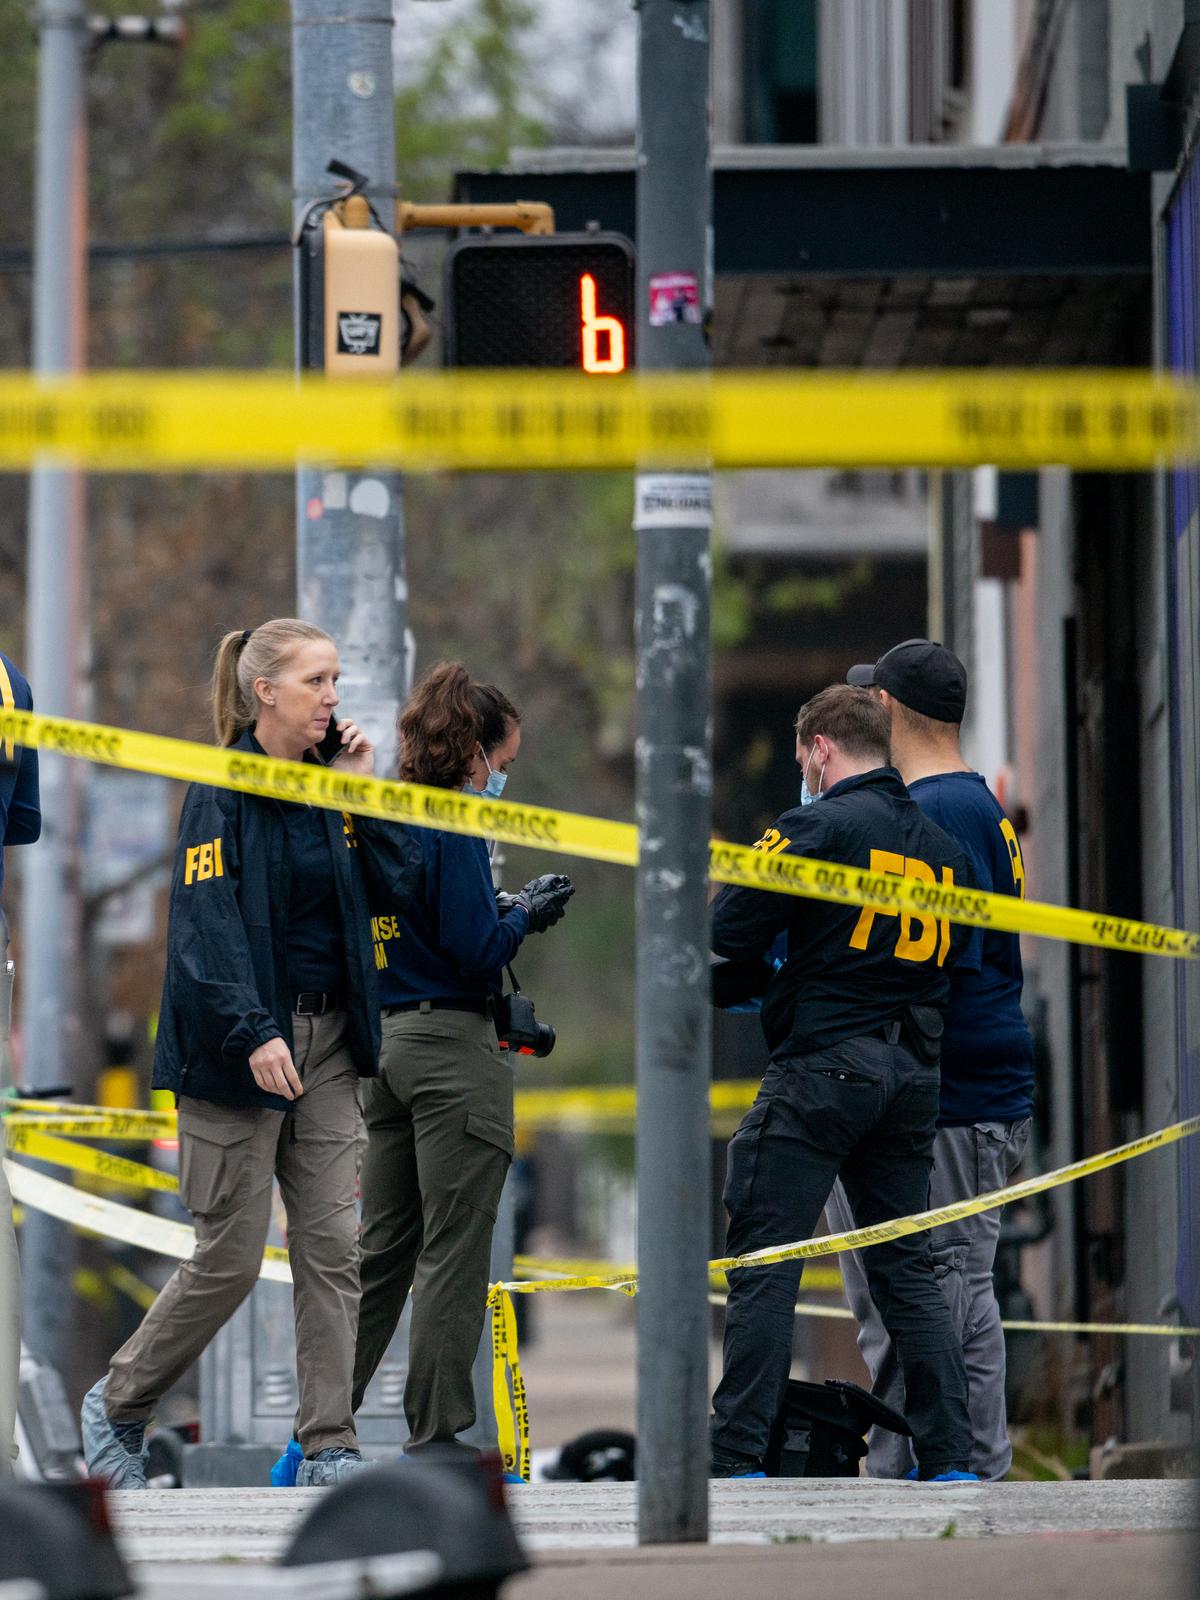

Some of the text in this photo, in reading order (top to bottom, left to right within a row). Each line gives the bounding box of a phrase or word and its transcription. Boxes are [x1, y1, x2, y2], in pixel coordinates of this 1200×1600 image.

[227, 757, 561, 843] POLICE LINE DO NOT CROSS
[185, 838, 223, 885] FBI
[752, 857, 808, 889] LINE
[814, 867, 848, 896] DO
[856, 875, 902, 906] NOT
[910, 885, 992, 921] CROSS
[849, 848, 953, 967] FBI
